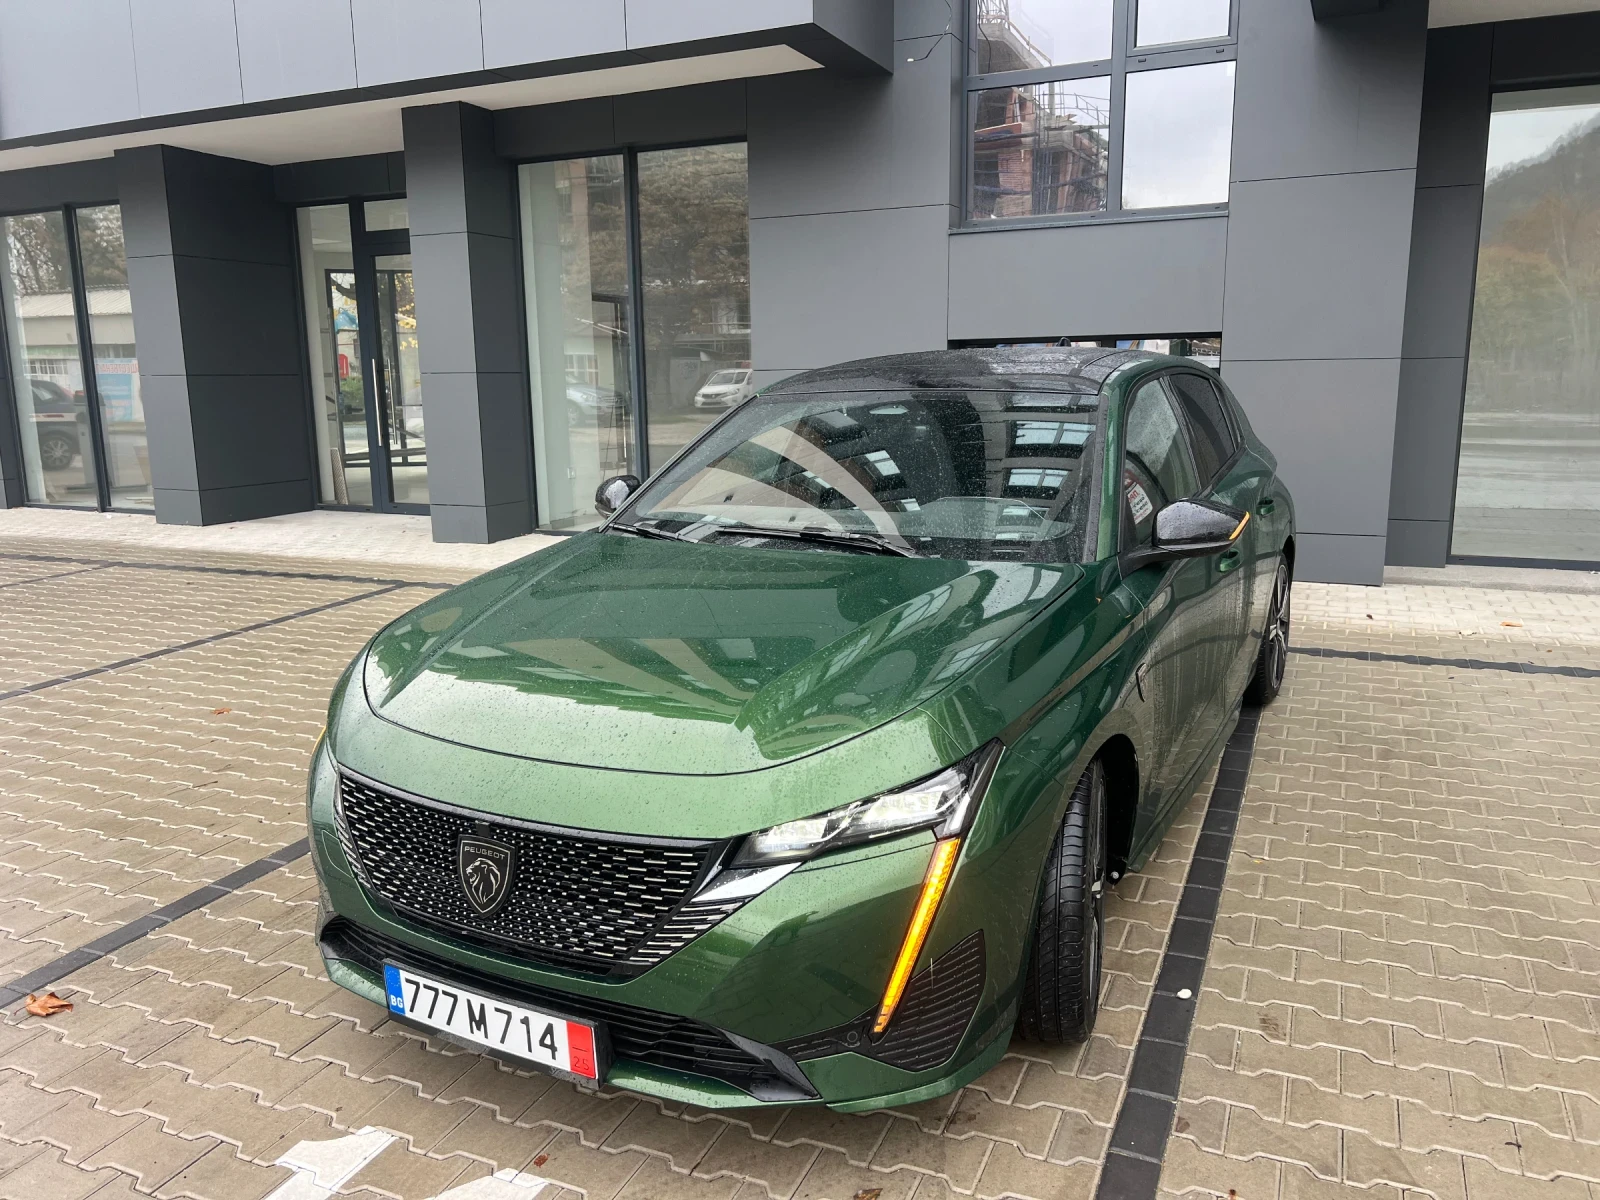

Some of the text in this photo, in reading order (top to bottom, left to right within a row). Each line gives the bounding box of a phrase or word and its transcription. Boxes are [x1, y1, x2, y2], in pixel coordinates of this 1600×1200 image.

[464, 846, 505, 860] PEUGEOT
[390, 995, 404, 1009] BG
[573, 1055, 590, 1071] 25
